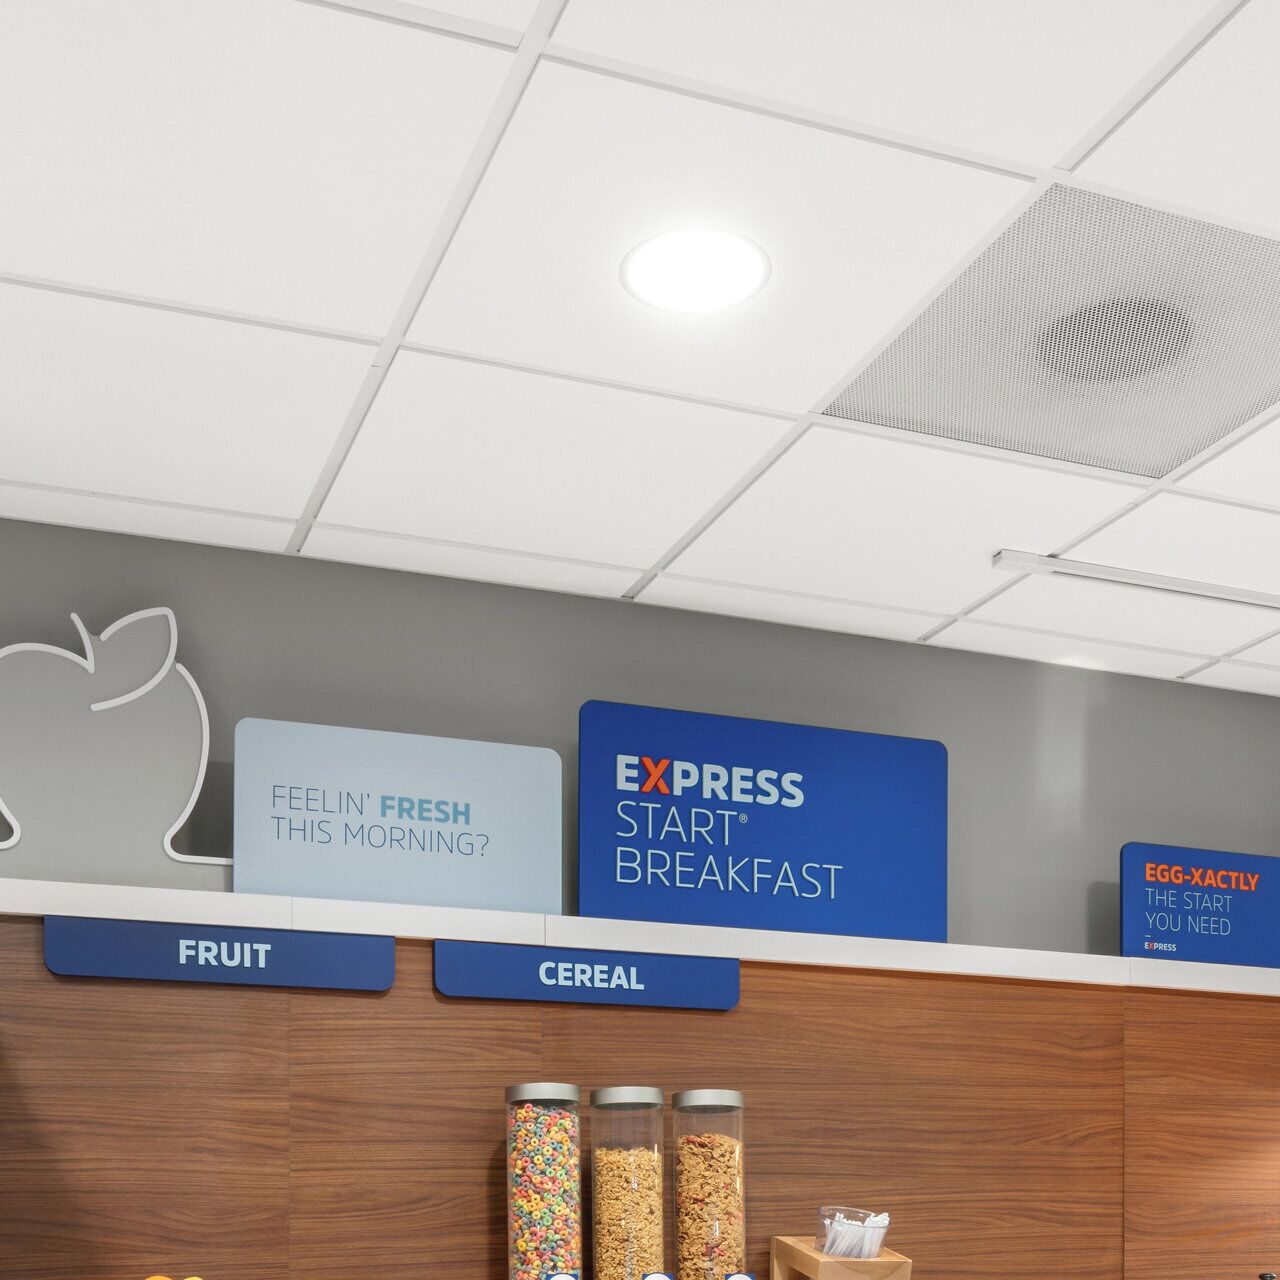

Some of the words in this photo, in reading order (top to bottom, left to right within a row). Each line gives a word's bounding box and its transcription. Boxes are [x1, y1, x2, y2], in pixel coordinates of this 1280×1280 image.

[616, 754, 805, 808] EXPRESS
[380, 794, 471, 825] FRESH
[271, 816, 332, 844] THIS
[344, 822, 490, 857] MORNING?
[616, 846, 843, 900] BREAKFAST
[1145, 863, 1260, 891] EGG-XACTLY
[1145, 888, 1177, 908] THE
[1184, 891, 1232, 912] START
[1145, 911, 1181, 932] YOU
[1188, 915, 1231, 936] NEED
[178, 939, 272, 969] FRUIT
[1144, 941, 1177, 951] EXPRESS
[538, 961, 645, 990] CEREAL
